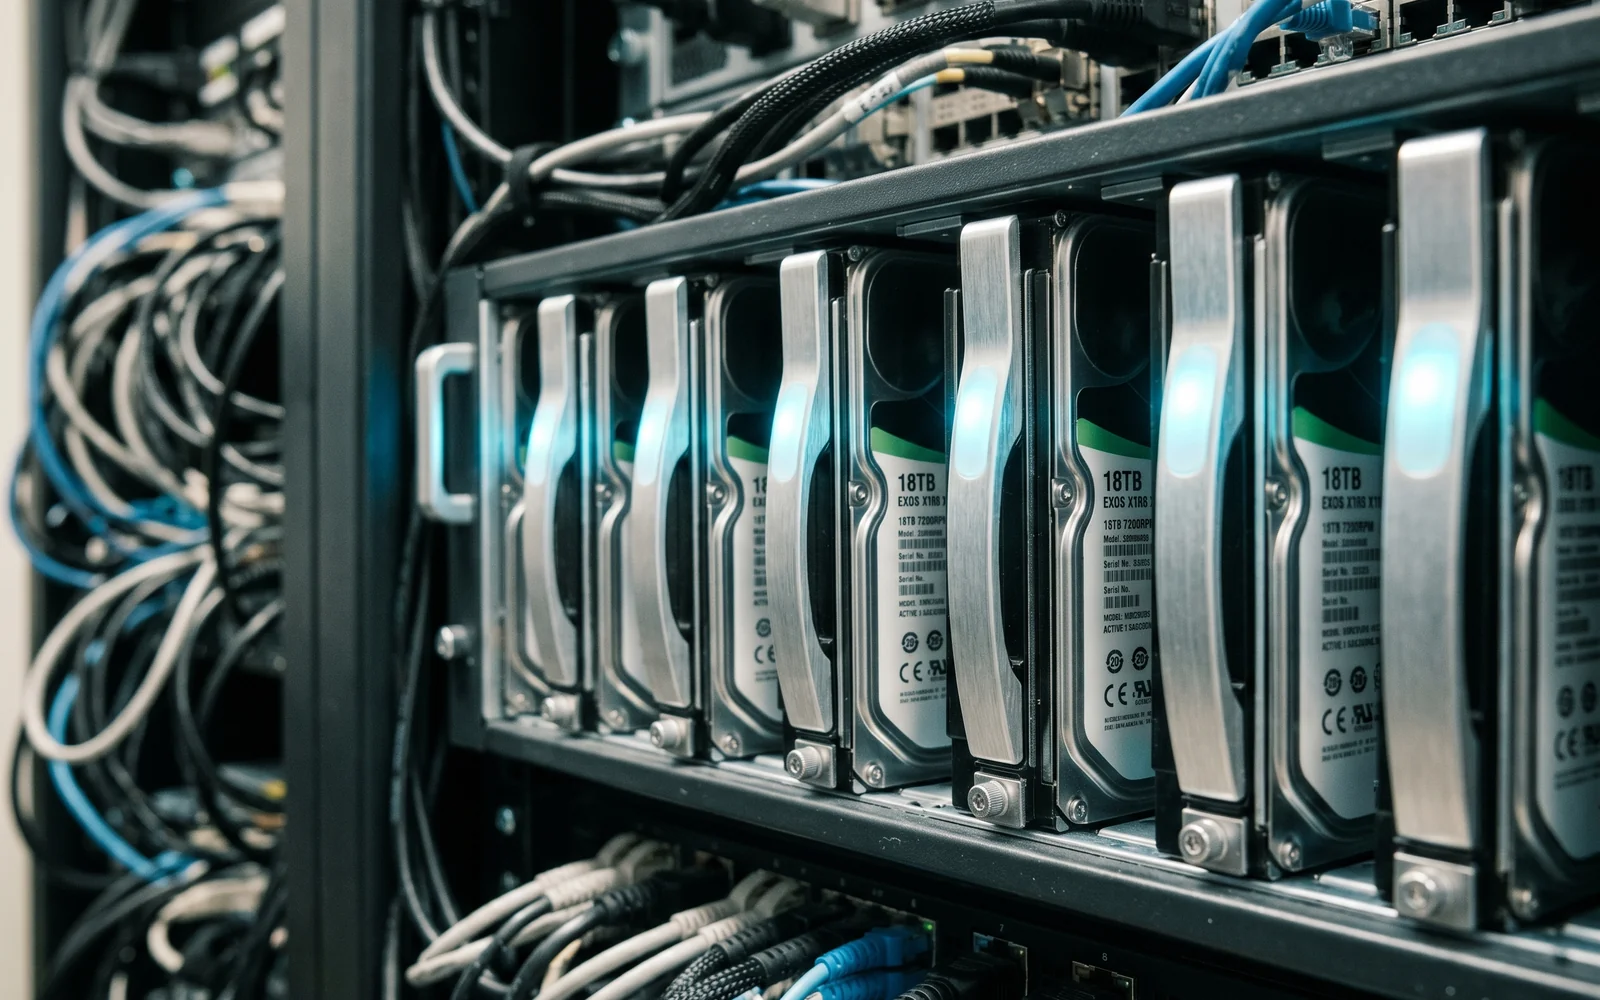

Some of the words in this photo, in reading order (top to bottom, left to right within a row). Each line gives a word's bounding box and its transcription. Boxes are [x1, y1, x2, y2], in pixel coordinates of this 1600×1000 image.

[898, 473, 936, 492] 18TB
[1103, 470, 1142, 491] 18TB
[1322, 466, 1361, 490] 18TB
[898, 496, 920, 507] EXOS
[1103, 496, 1126, 509] EXOS
[1103, 623, 1124, 634] ACTIVE
[1110, 656, 1120, 667] 20
[1136, 653, 1145, 665] 20
[899, 661, 923, 683] CE
[1104, 682, 1128, 707] CE
[1321, 706, 1346, 735] CE
[1000, 924, 1004, 932] 7
[1102, 952, 1108, 961] 8
